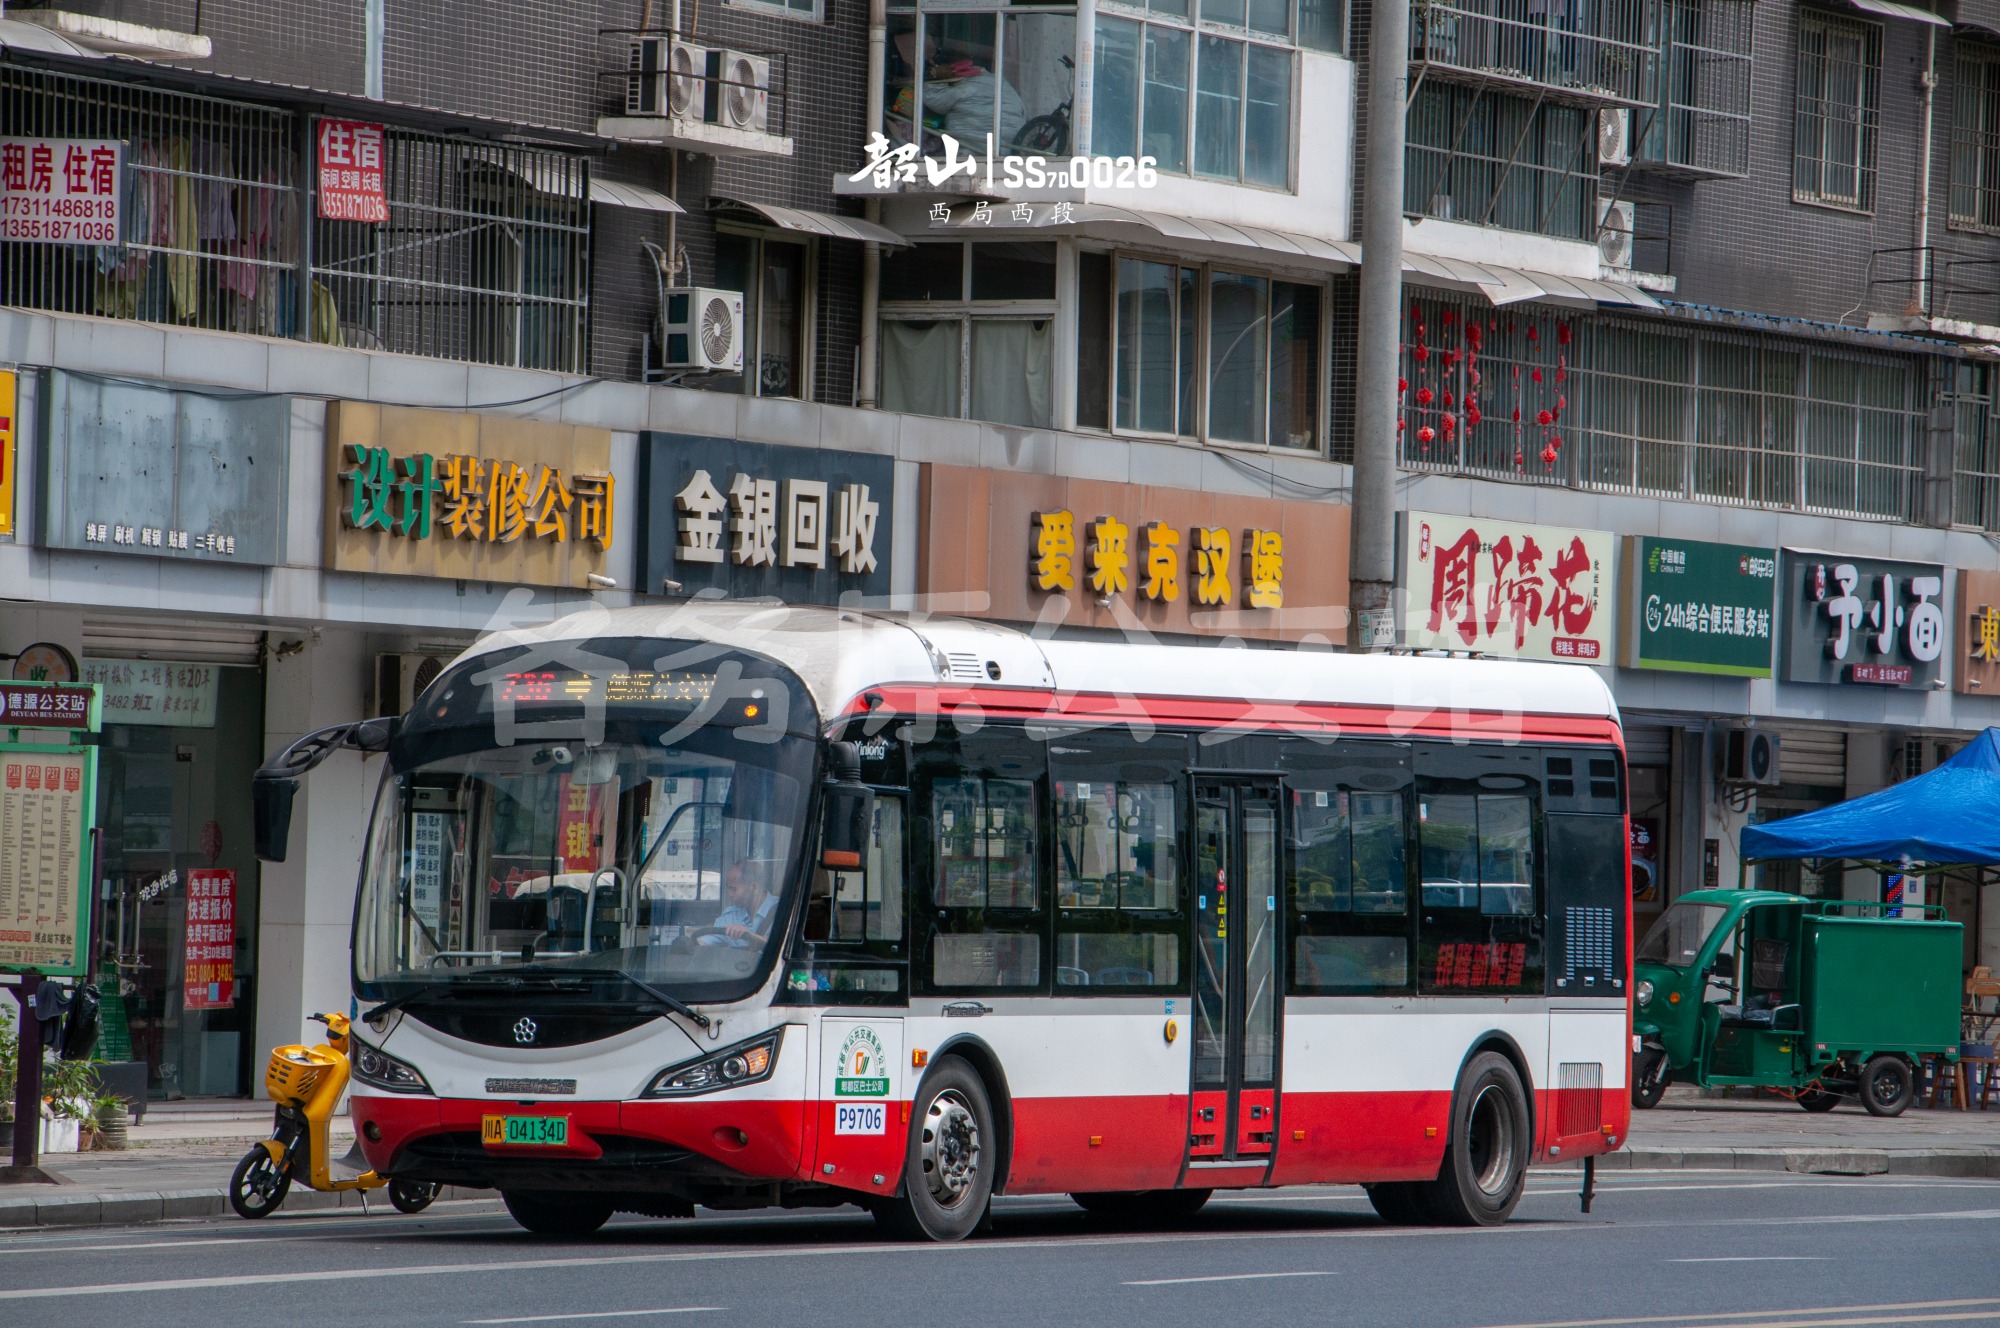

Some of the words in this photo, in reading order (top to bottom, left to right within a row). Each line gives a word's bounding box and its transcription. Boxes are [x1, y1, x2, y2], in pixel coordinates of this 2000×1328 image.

[321, 122, 381, 169] 住宿
[2, 143, 53, 194] 租房
[63, 144, 115, 195] 住宿
[321, 168, 339, 188] 标间
[341, 170, 360, 190] 空调
[362, 172, 381, 192] 长租
[0, 197, 115, 219] 17311486818
[0, 219, 115, 241] 13551871036
[342, 444, 615, 550] 设计装修公司
[674, 469, 880, 574] 金银回收
[86, 523, 107, 543] 换屏
[114, 525, 135, 545] 刷机
[141, 527, 162, 547] 解锁
[168, 530, 188, 550] 贴膜
[195, 533, 235, 554] 二手收售
[1032, 508, 1283, 609] 爱来克汉堡
[1660, 549, 1686, 565] 中国邮政
[1660, 565, 1674, 574] CHINA
[1674, 566, 1686, 574] POST
[1426, 528, 1594, 650] 周蹄花
[1664, 602, 1770, 638] 24h综合便民服务站
[8, 692, 85, 711] 德源公交站
[27, 765, 40, 778] P28
[46, 766, 59, 779] P37
[66, 768, 79, 780] 736
[565, 781, 591, 872] 金银
[139, 869, 178, 901] 欢迎光临
[191, 877, 231, 897] 免费量房
[187, 899, 233, 921] 快速报价
[187, 923, 232, 943] 免费平面设计
[185, 963, 197, 983] 153
[199, 963, 215, 983] 0804
[217, 963, 233, 982] 3482
[837, 1027, 885, 1077] 成都市公共交通集团公司
[839, 1107, 882, 1130] P9706
